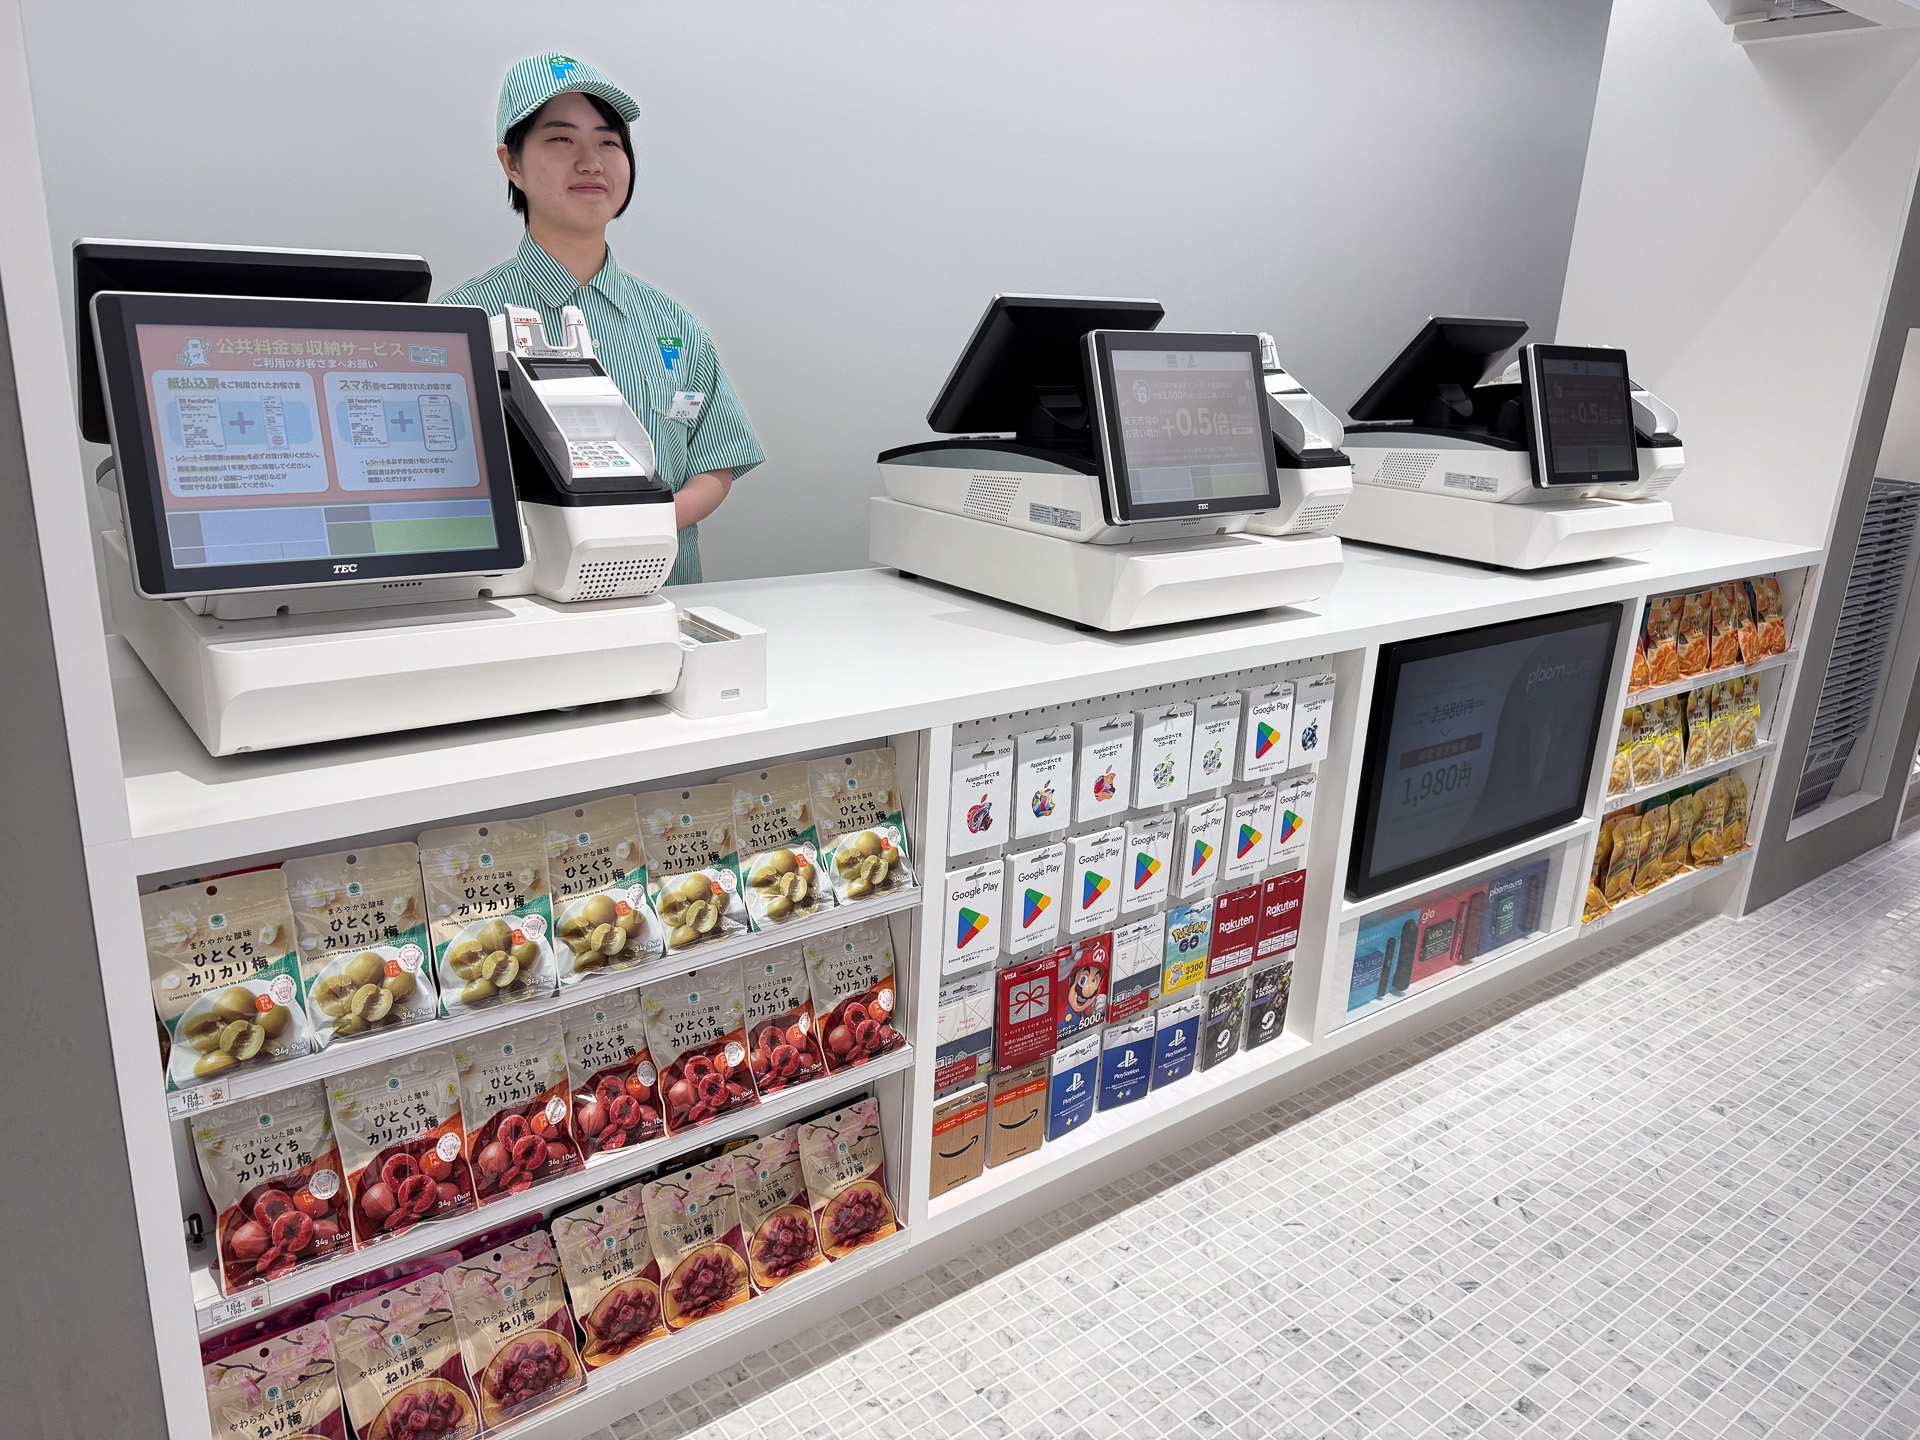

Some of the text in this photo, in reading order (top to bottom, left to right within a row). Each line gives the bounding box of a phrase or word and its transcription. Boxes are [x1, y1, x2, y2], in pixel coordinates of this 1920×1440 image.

[215, 337, 405, 358] 公共料金等収納サービス
[252, 357, 378, 369] ご利用のお客さまへお願い
[167, 377, 302, 390] 紙払込票をご利用されたお客さま
[339, 379, 452, 391] スマホ等をご利用されたお客さま
[332, 563, 358, 574] TEC
[1252, 701, 1290, 715] Google Play
[1120, 720, 1133, 729] 5000
[1058, 733, 1072, 741] 3000
[998, 747, 1011, 755] 1500
[1401, 763, 1472, 808] 1,980円
[837, 792, 873, 804] まろやかな酸味
[1280, 790, 1313, 805] Google Play
[749, 807, 786, 821] まろやかな酸味
[840, 800, 876, 816] ひとくち
[1235, 804, 1272, 819] Google Play
[751, 816, 789, 835] ひとくち
[837, 811, 887, 830] カリカリ梅
[1191, 818, 1222, 834] Google Play
[665, 829, 708, 842] まろやかな酸味
[749, 827, 799, 848] カリカリ梅
[1131, 831, 1171, 846] Google Play
[563, 846, 610, 863] まろやかな酸味
[667, 839, 710, 856] ひとくち
[1078, 848, 1120, 865] Google Play
[565, 856, 613, 879] ひとくち
[663, 851, 720, 871] カリカリ梅
[462, 870, 514, 884] まろやかな酸味
[560, 868, 626, 895] カリカリ梅
[1018, 864, 1061, 882] Google Play
[464, 881, 516, 899] ひとくち
[952, 882, 999, 901] Google Play
[327, 899, 385, 916] まろやかな酸味
[457, 894, 526, 917] カリカリ梅
[1266, 899, 1299, 917] Rakuten
[1502, 902, 1514, 912] evo
[330, 911, 386, 932] ひとくち
[1219, 914, 1254, 933] Rakuten
[1421, 909, 1436, 924] glo
[189, 929, 253, 950] まろやかな酸味
[323, 925, 399, 950] カリカリ梅
[1178, 935, 1200, 953] GO
[193, 941, 255, 968] ひとくち
[635, 943, 647, 953] 34g
[829, 954, 874, 970] すっきりとした酸味
[1185, 961, 1204, 975] 3300
[186, 955, 269, 988] カリカリ梅
[836, 963, 873, 981] ひとくち
[1004, 972, 1017, 980] VISA
[527, 978, 539, 986] 34g
[747, 976, 793, 991] すっきりとした酸味
[832, 974, 879, 996] カリカリ梅
[169, 991, 190, 1002] Crunchy
[202, 985, 219, 995] Plums
[219, 982, 229, 991] with
[752, 986, 790, 1004] ひとくち
[402, 1007, 433, 1019] 34g 9kcal
[669, 1005, 721, 1021] すっきりとした酸味
[747, 997, 800, 1019] カリカリ梅
[675, 1015, 716, 1034] ひとくち
[1078, 1012, 1101, 1029] 5000
[576, 1023, 629, 1043] すっきりとした酸味
[670, 1026, 726, 1048] カリカリ梅
[1259, 1028, 1274, 1039] STEAM
[274, 1042, 307, 1057] 34g 9kcal
[582, 1034, 625, 1055] ひとくち
[1165, 1045, 1188, 1059] PlayStation
[1215, 1047, 1229, 1058] STEAM
[481, 1057, 540, 1076] すっきりとした酸味
[580, 1046, 637, 1070] カリカリ梅
[490, 1069, 536, 1090] ひとくち
[1113, 1068, 1140, 1080] PlayStation
[363, 1090, 430, 1114] すっきりとした酸味
[484, 1081, 547, 1107] カリカリ梅
[730, 1096, 741, 1104] 34g
[1062, 1090, 1086, 1106] PlayStation
[373, 1103, 427, 1128] ひとくち
[641, 1120, 653, 1129] 34g
[232, 1126, 303, 1152] すっきりとした酸味
[367, 1115, 439, 1146] カリカリ梅
[243, 1139, 300, 1166] ひとくち
[817, 1146, 874, 1175] やわらかく甘酸っぱい
[236, 1151, 313, 1184] カリカリ梅
[548, 1157, 560, 1167] 34g
[835, 1162, 865, 1182] ねり梅
[738, 1172, 796, 1204] やわらかく甘酸っぱい
[438, 1191, 471, 1209] 34g 10kcal
[758, 1188, 787, 1209] ねり梅
[662, 1207, 727, 1237] やわらかく甘酸っぱい
[314, 1231, 350, 1248] 34g 10kcal
[683, 1224, 714, 1245] ねり梅
[581, 1240, 647, 1275] やわらかく甘酸っぱい
[602, 1257, 634, 1281] ねり梅
[474, 1289, 550, 1328] やわらかく甘酸っぱい
[498, 1308, 536, 1334] ねり梅
[359, 1335, 441, 1379] やわらかく甘酸っぱい
[385, 1356, 425, 1385] ねり梅
[229, 1389, 322, 1432] やわらかく甘酸っぱい
[257, 1410, 303, 1440] ねり梅
